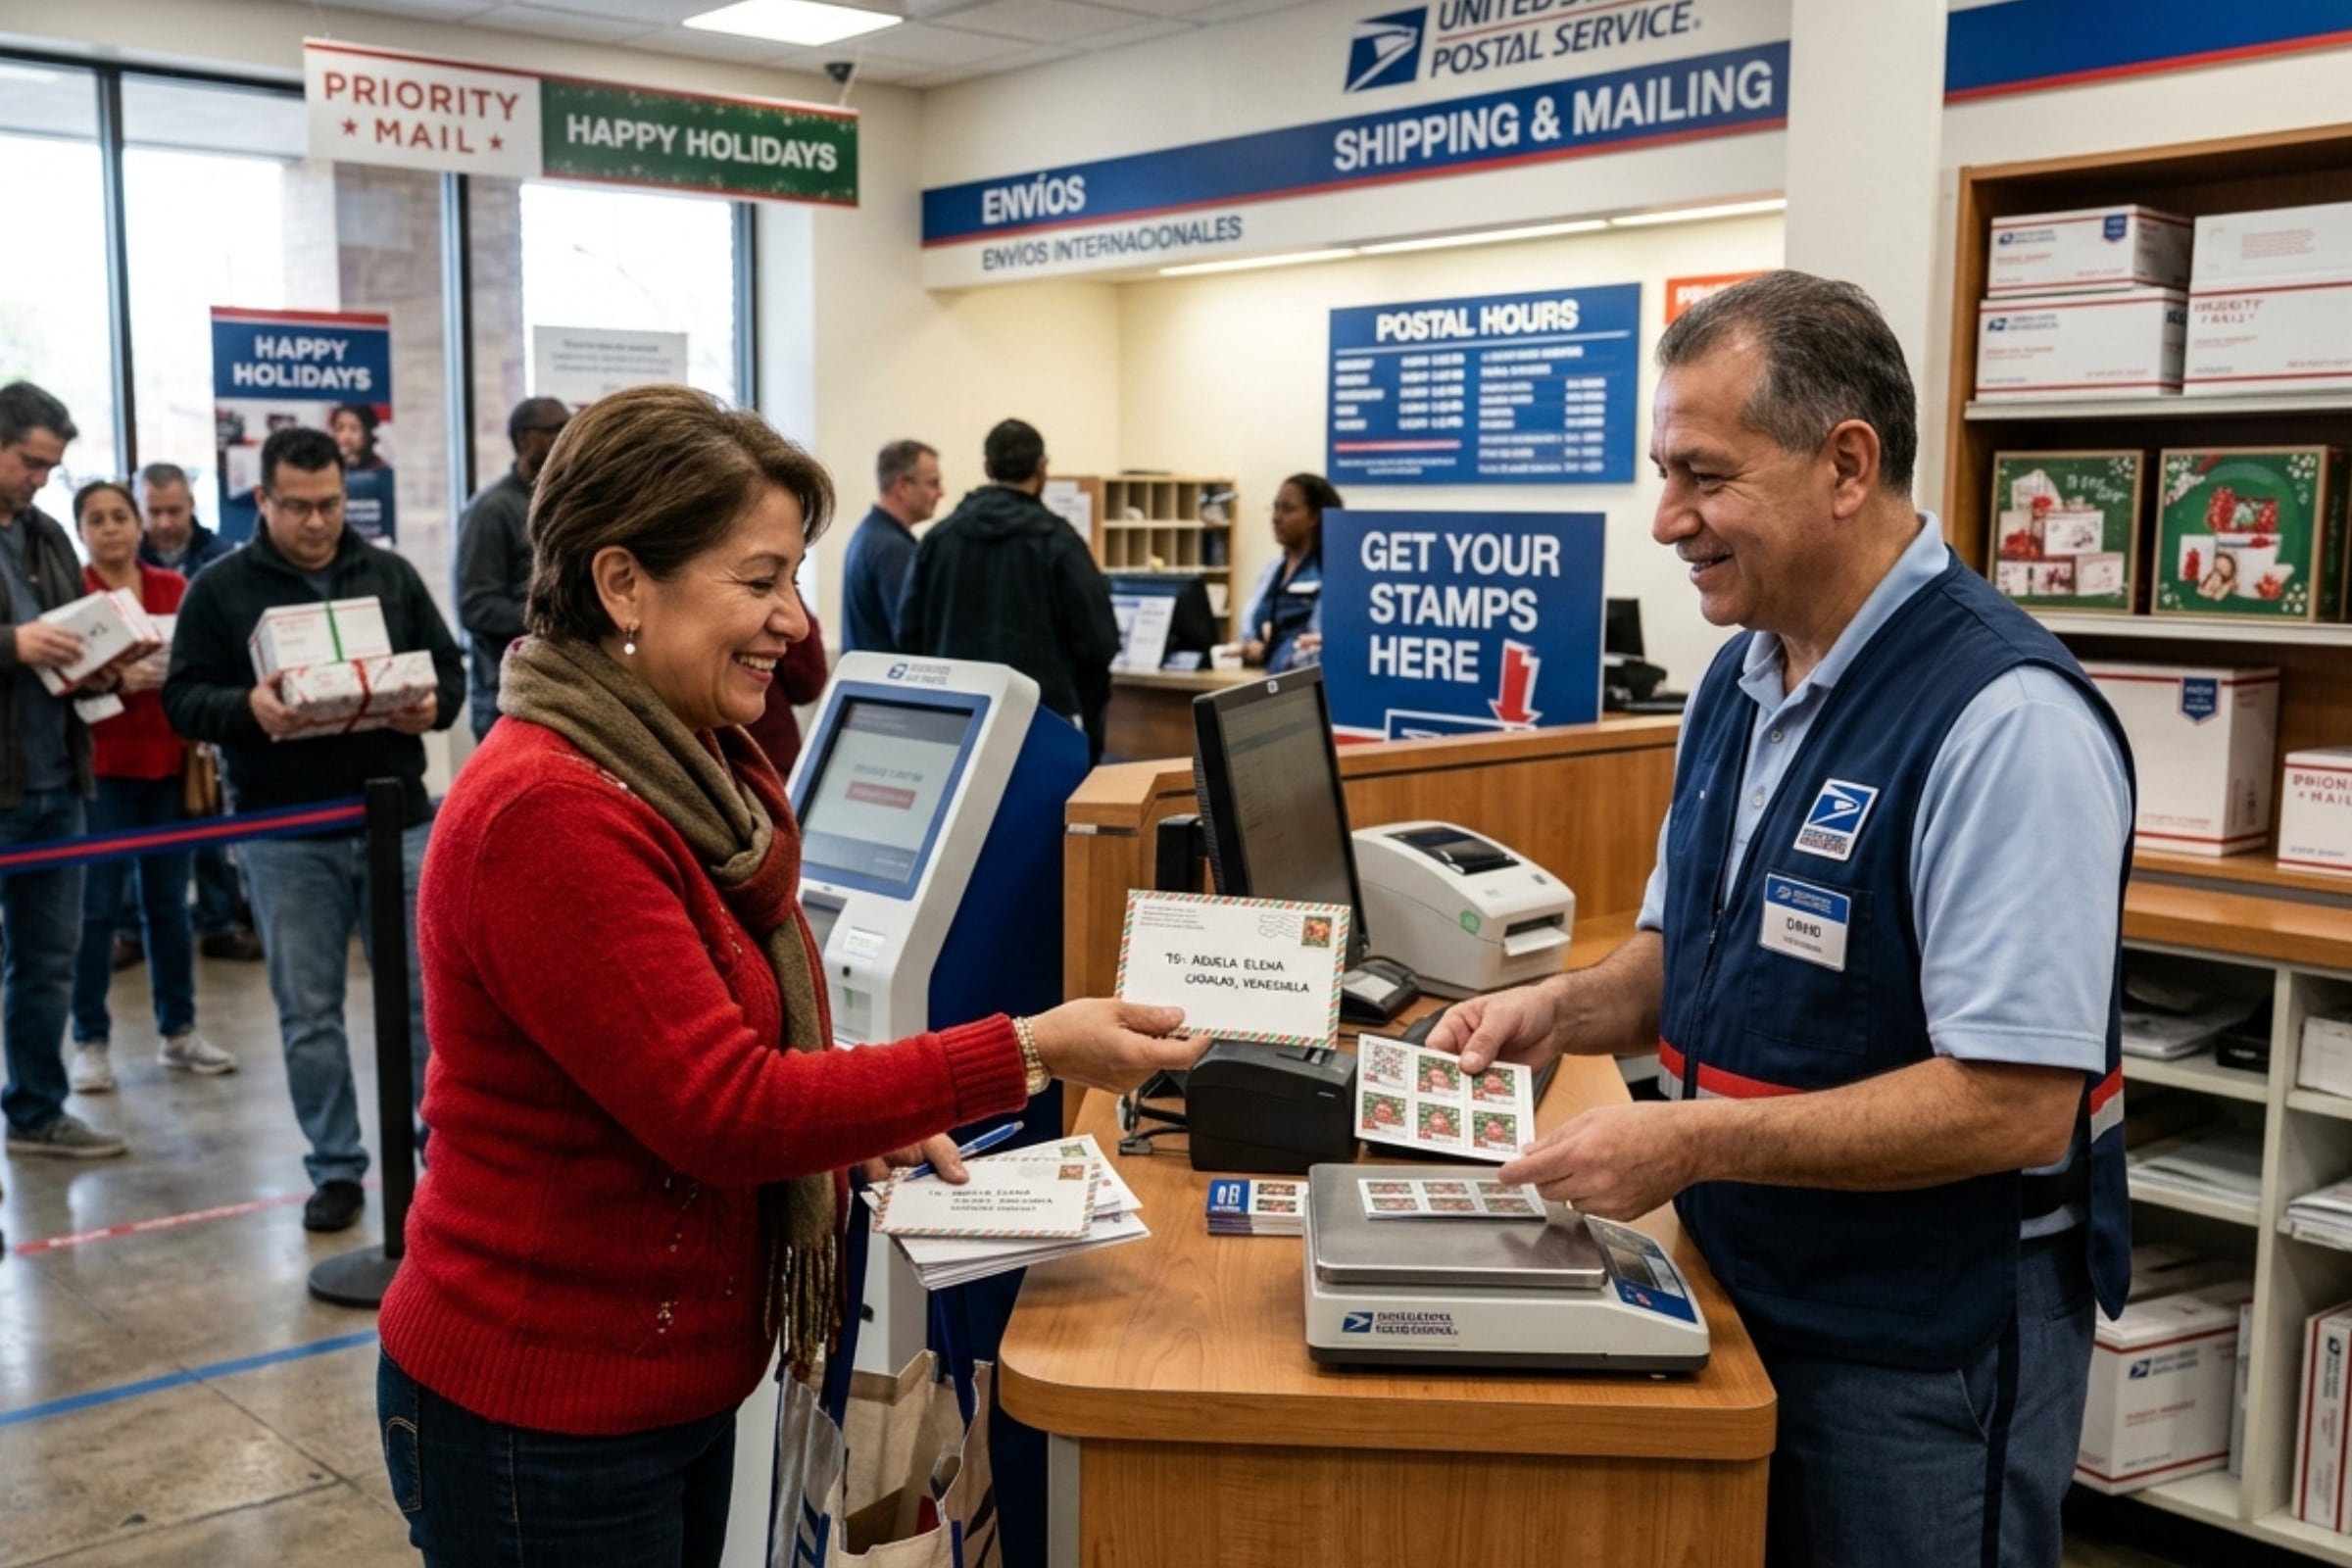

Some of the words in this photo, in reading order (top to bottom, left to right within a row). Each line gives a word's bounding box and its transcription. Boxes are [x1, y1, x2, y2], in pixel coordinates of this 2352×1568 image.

[1431, 30, 1544, 77] POSTAL
[324, 71, 518, 122] PRIORITY
[1334, 103, 1520, 172] SHIPPING
[1531, 96, 1562, 142] &
[1573, 61, 1773, 136] MAILING
[374, 119, 475, 155] MAIL
[567, 113, 677, 154] HAPPY
[686, 128, 838, 173] HOLIDAYS
[982, 173, 1086, 224] ENVÍOS
[1054, 216, 1243, 261] INTERNACIONALES
[1376, 311, 1475, 341] POSTAL
[1480, 299, 1579, 334] HOURS
[255, 335, 348, 362] HAPPY
[233, 363, 372, 392] HOLIDAYS
[1360, 531, 1437, 572] GET
[1445, 533, 1560, 577] YOUR
[1369, 582, 1539, 633] STAMPS
[1369, 635, 1481, 683] HERE
